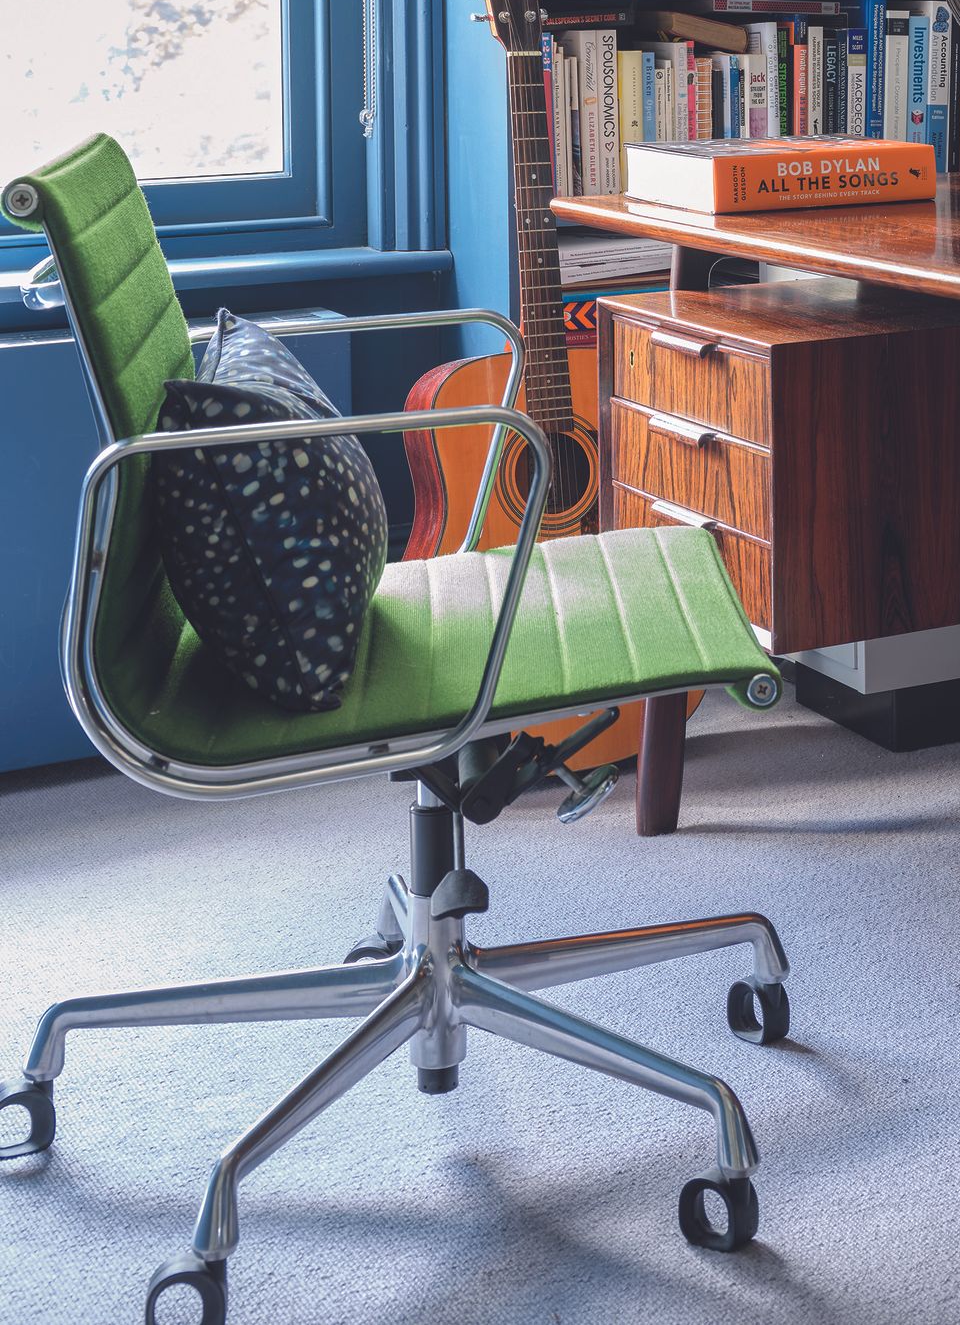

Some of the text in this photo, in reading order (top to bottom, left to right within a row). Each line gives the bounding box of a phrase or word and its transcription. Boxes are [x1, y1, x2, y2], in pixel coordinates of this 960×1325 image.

[585, 15, 603, 23] SECRET
[584, 41, 597, 92] Committed
[798, 49, 807, 95] Private equity
[826, 45, 837, 83] LEGACY
[912, 27, 927, 103] Investments
[939, 34, 949, 88] Accounting
[602, 35, 616, 138] SPOUSONOMICS
[778, 62, 786, 108] STRATEGY
[757, 171, 899, 194] ALL THE SONGS
[776, 157, 880, 178] BOB DYLAN
[792, 192, 813, 200] STORY
[814, 191, 837, 199] BEHIND
[838, 190, 858, 198] EVERY
